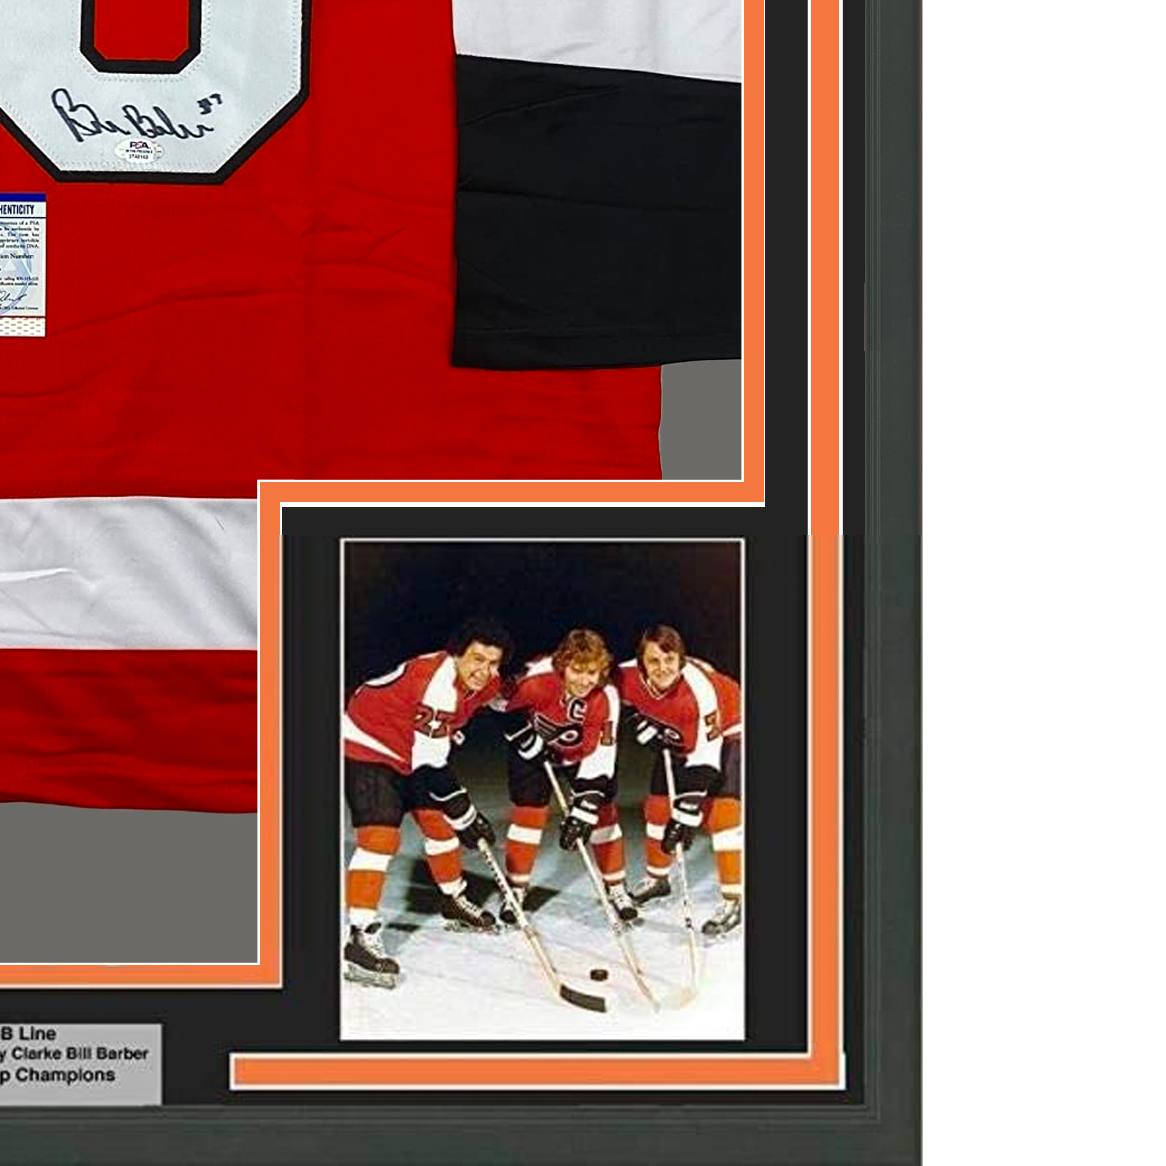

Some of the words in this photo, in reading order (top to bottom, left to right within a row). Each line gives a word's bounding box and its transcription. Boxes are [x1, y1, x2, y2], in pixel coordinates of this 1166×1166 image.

[129, 141, 151, 149] PSA
[19, 1026, 57, 1041] Line
[11, 1046, 62, 1060] Clarke
[66, 1046, 92, 1060] Bill
[96, 1046, 150, 1060] Barber
[15, 1067, 116, 1086] Champions
